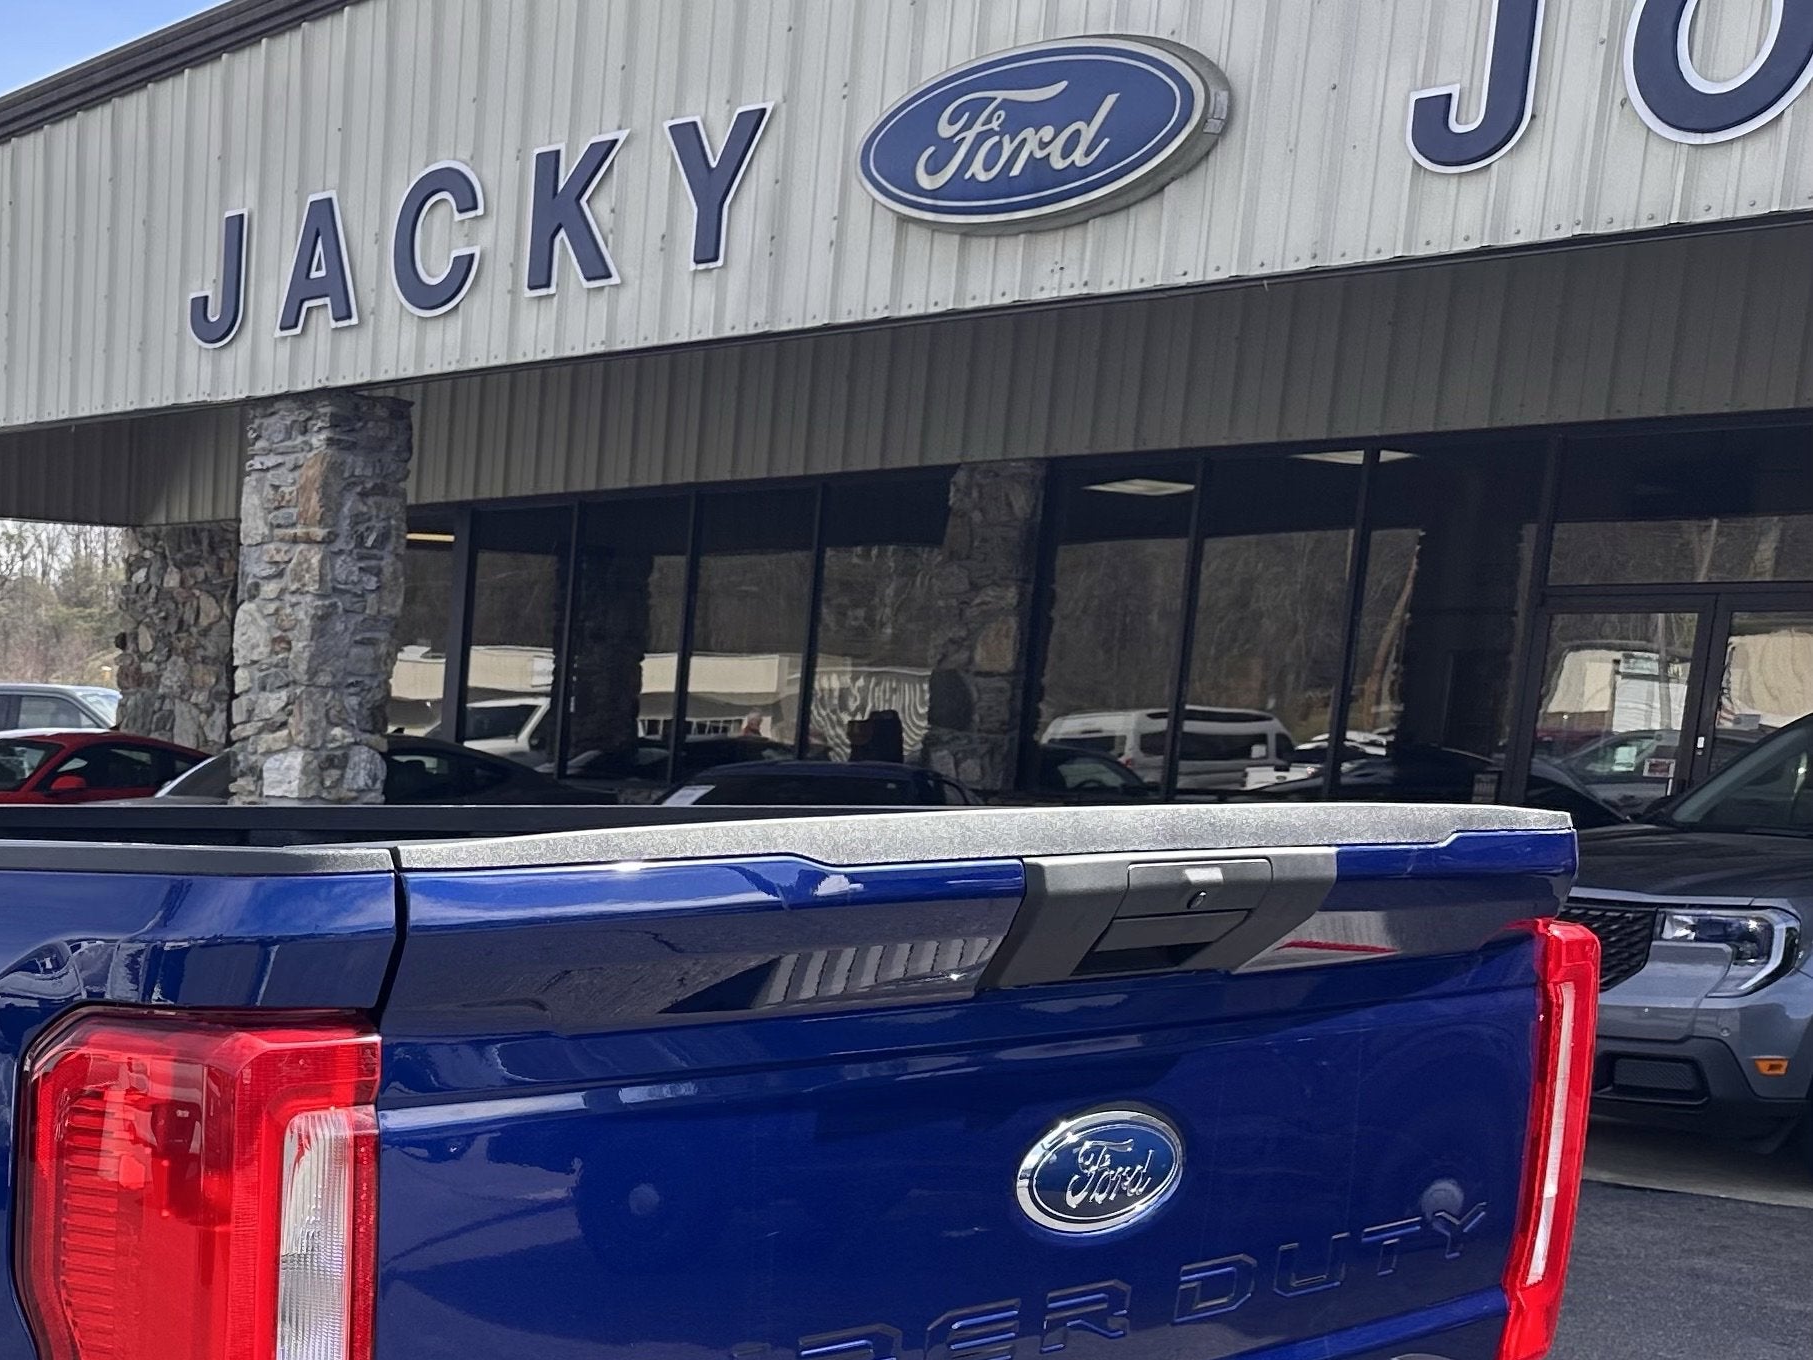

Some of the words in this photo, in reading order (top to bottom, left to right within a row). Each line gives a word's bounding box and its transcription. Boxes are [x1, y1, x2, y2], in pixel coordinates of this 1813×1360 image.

[915, 80, 1121, 190] Ford
[189, 101, 775, 349] JACKY
[1065, 1138, 1155, 1209] Ford
[1173, 1201, 1488, 1324] DUTY
